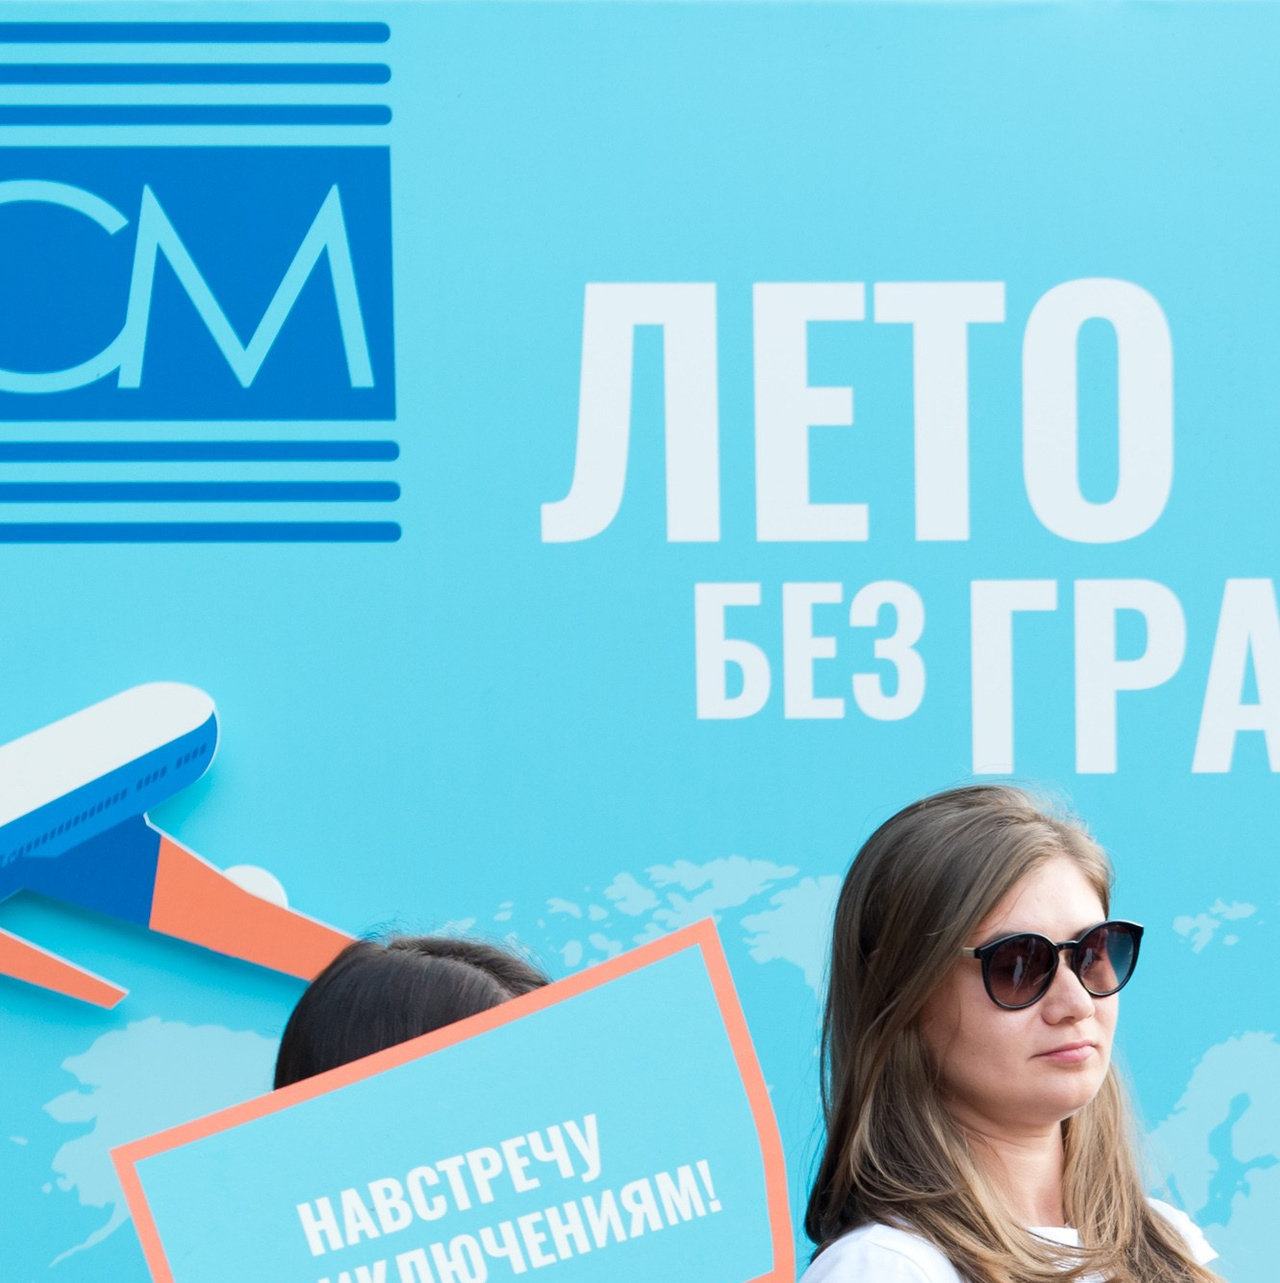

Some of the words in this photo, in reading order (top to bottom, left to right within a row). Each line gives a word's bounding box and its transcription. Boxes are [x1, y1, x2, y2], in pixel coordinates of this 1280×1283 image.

[0, 180, 374, 394] CM
[541, 277, 1174, 544] ЛЕТО
[694, 580, 926, 721] БЕЗ
[296, 1113, 602, 1257] НАВСТРЕЧУ
